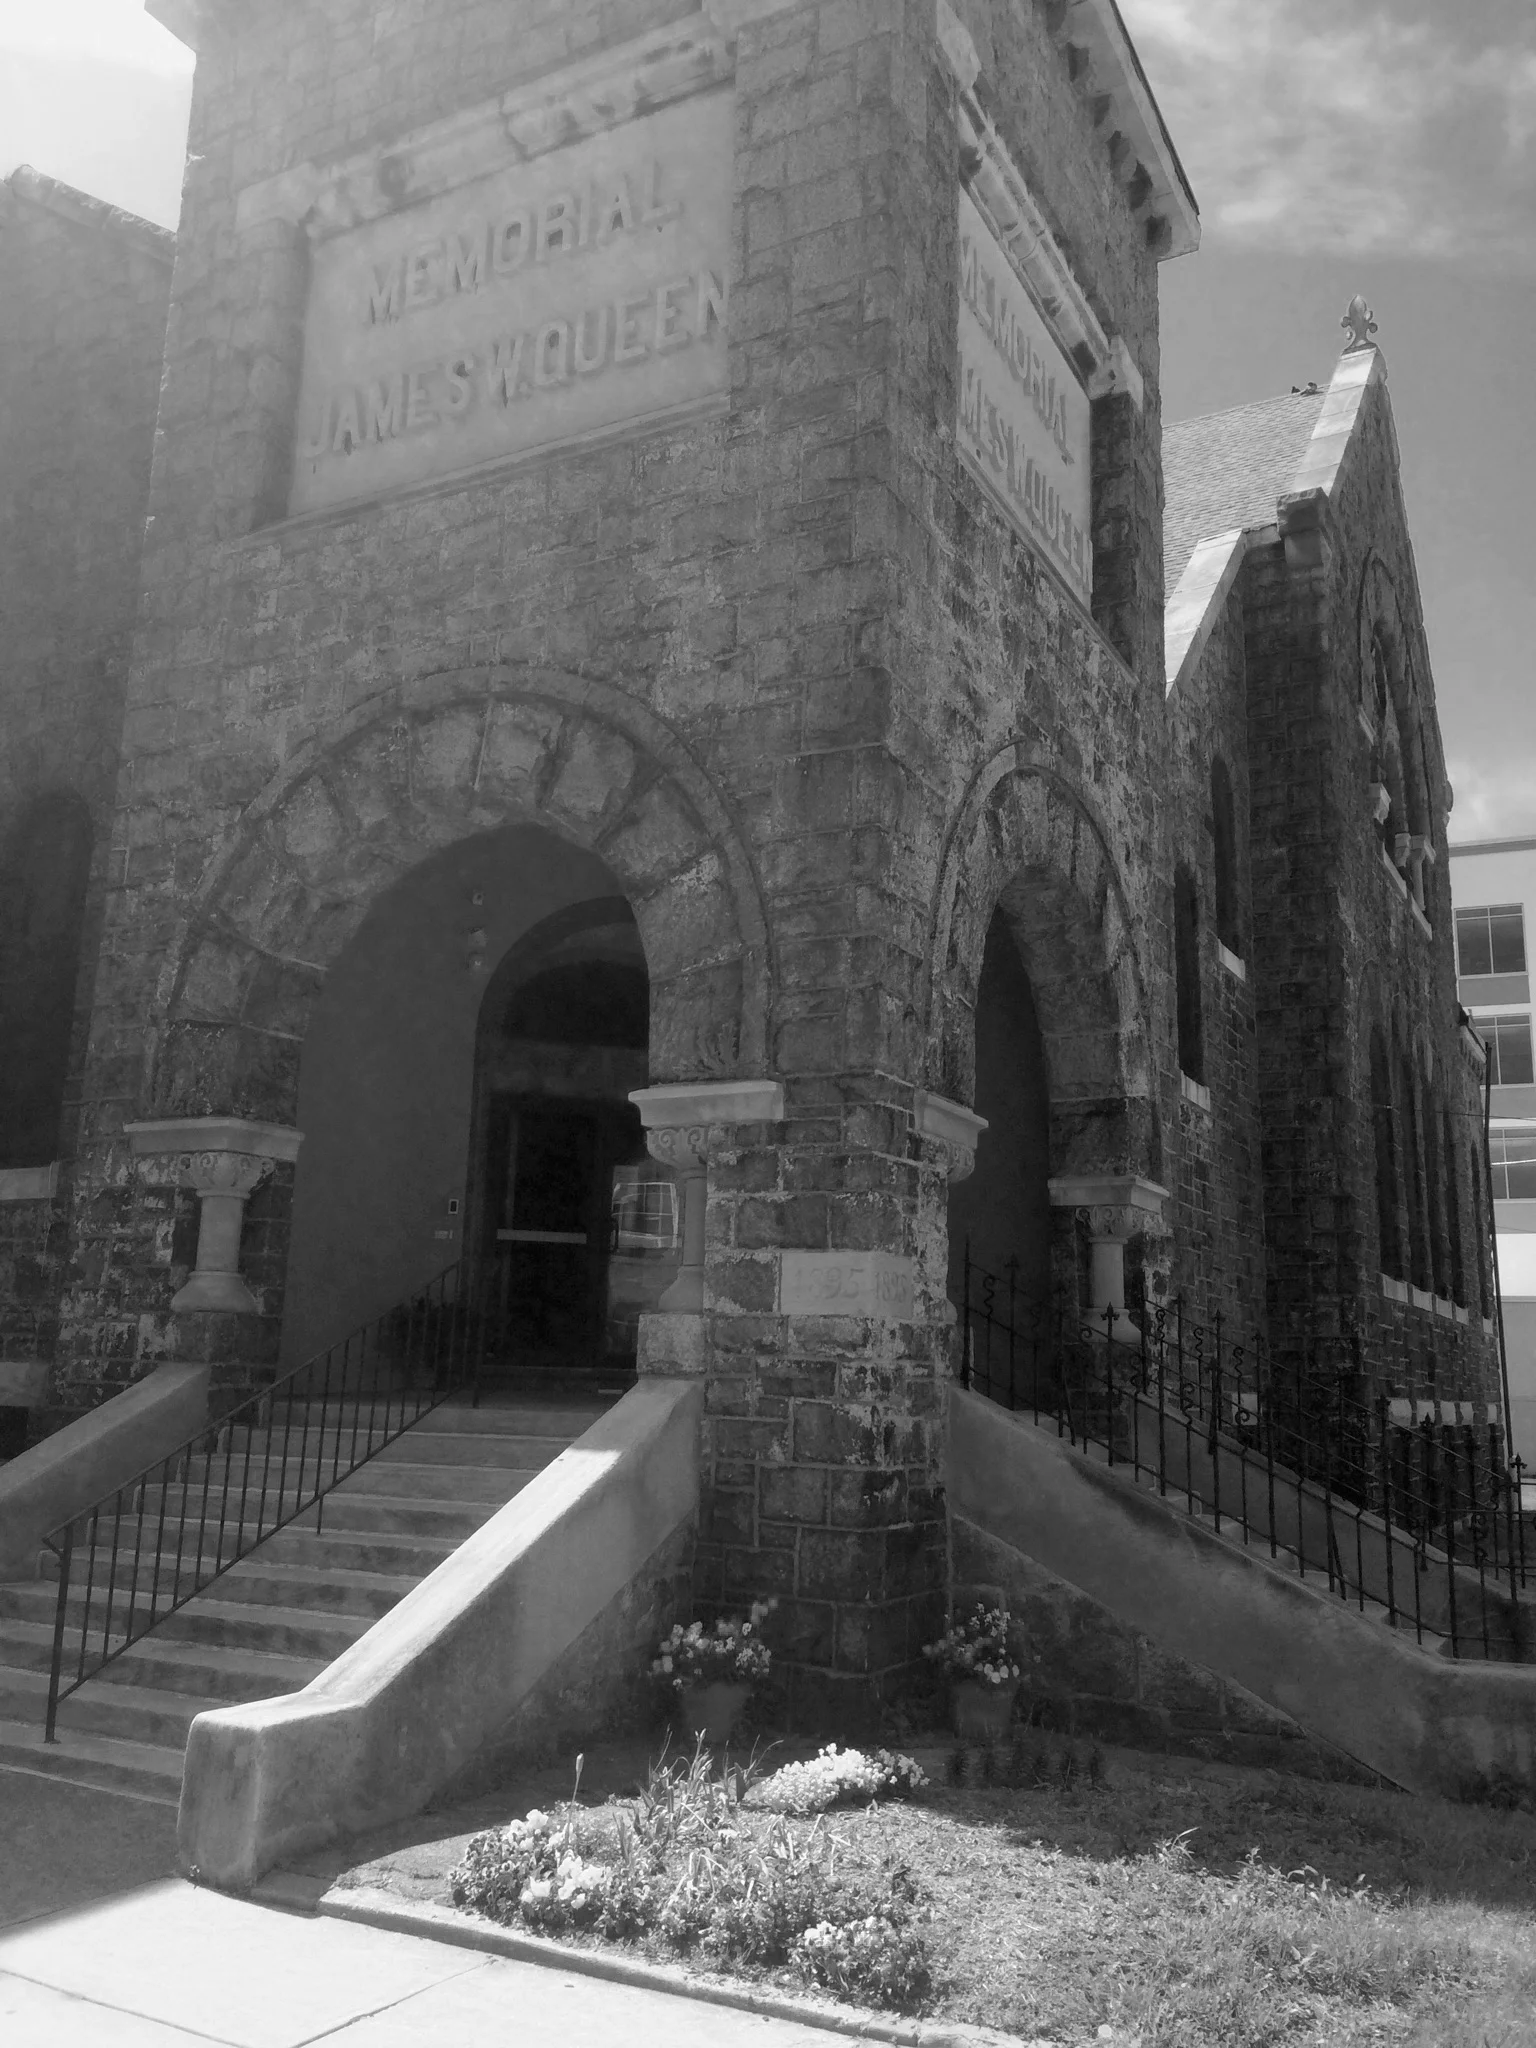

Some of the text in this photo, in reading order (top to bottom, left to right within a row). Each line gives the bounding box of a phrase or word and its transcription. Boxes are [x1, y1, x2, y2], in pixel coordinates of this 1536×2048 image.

[367, 161, 684, 326] MEMORIAL
[303, 350, 474, 460] JAMES
[533, 270, 730, 390] QUEEN
